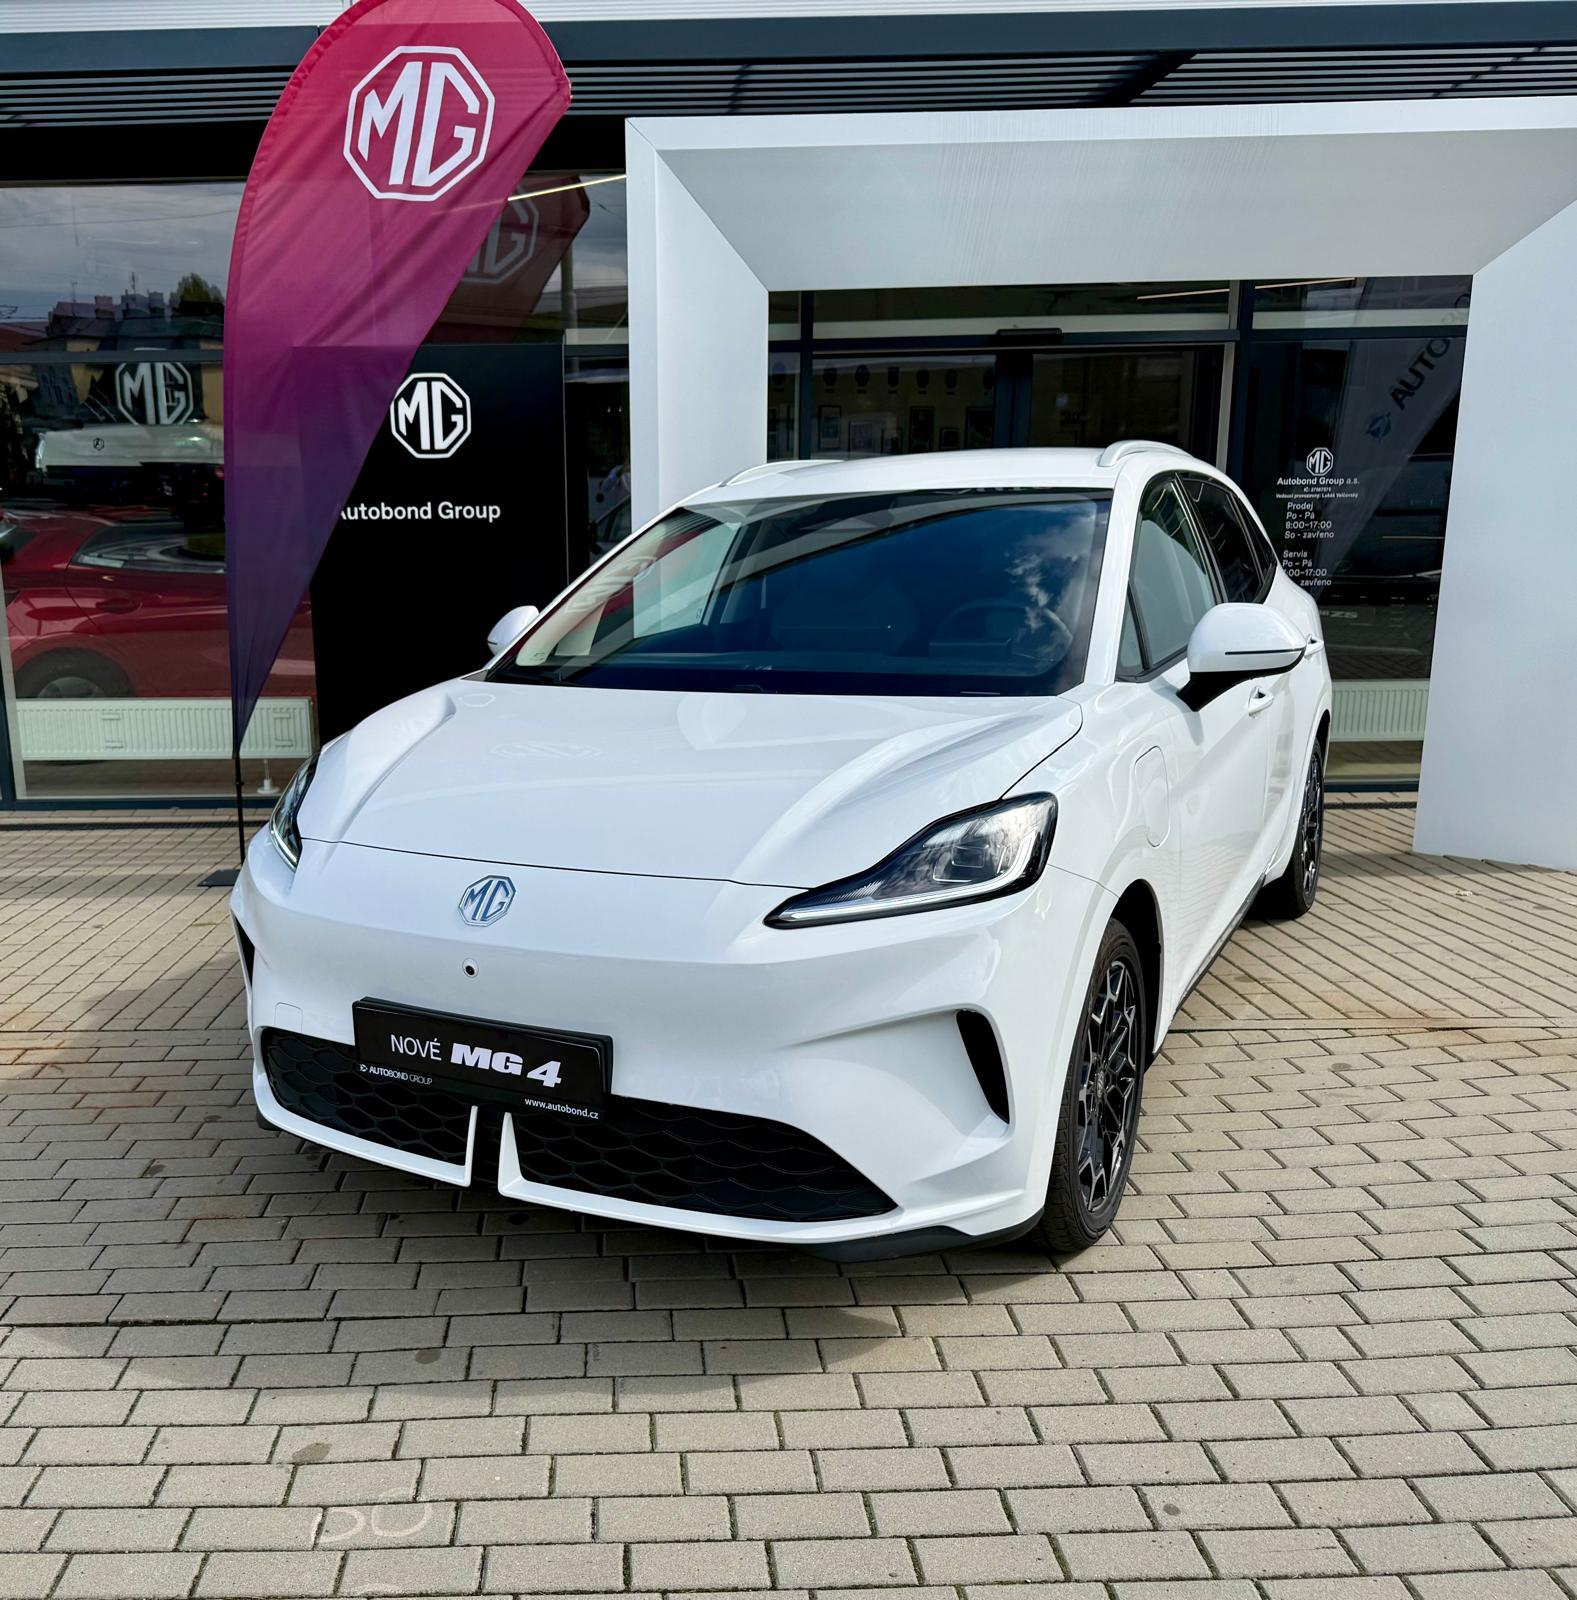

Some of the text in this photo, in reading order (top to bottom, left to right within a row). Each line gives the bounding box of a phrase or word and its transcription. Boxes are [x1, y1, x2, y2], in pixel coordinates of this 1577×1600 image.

[357, 60, 480, 187] MG
[123, 361, 186, 425] MG
[397, 380, 464, 451] MG
[1308, 450, 1331, 474] MG
[1277, 477, 1317, 486] Autobond
[1319, 477, 1344, 487] Group
[438, 501, 501, 523] Group
[1286, 511, 1297, 520] Po
[1304, 511, 1315, 520] Pá
[1287, 501, 1314, 511] Prodej
[1284, 530, 1296, 539] So
[1302, 530, 1335, 539] zavřeno
[1282, 559, 1293, 568] Po
[1302, 558, 1313, 567] Pá
[1283, 549, 1308, 558] Servis
[1300, 578, 1332, 586] zavřeno
[463, 879, 510, 922] MG
[390, 1034, 562, 1088] NOVÉ MG 4
[368, 1066, 433, 1086] AUTOBOND GROUP
[524, 1097, 599, 1120] www.autobond.cz
